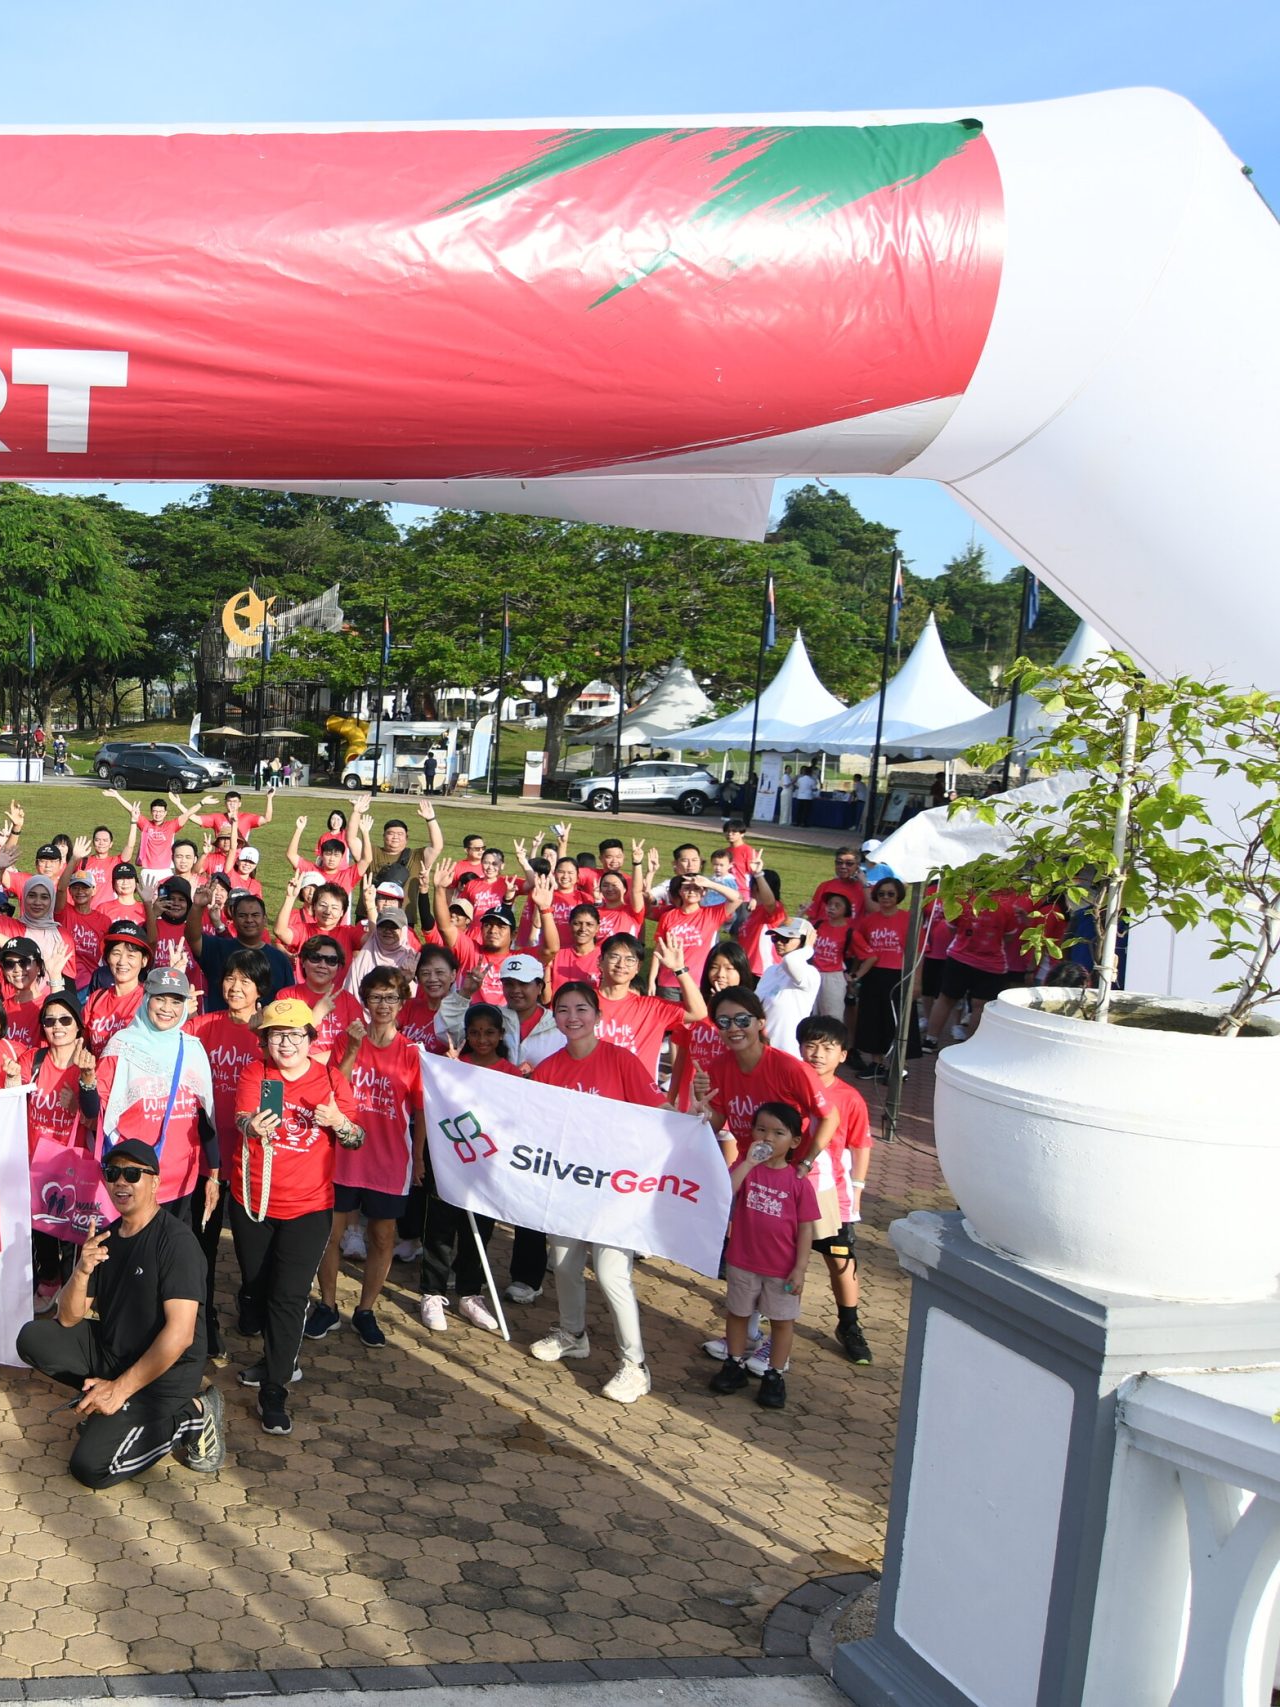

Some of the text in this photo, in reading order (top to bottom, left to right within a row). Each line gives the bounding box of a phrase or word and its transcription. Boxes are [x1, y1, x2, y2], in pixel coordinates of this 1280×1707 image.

[161, 978, 181, 986] NY
[217, 1045, 254, 1066] Walk
[356, 1066, 391, 1091] Walk
[509, 1143, 701, 1203] SilverGenz
[76, 1201, 102, 1210] WALK
[72, 1212, 107, 1227] HOPE
